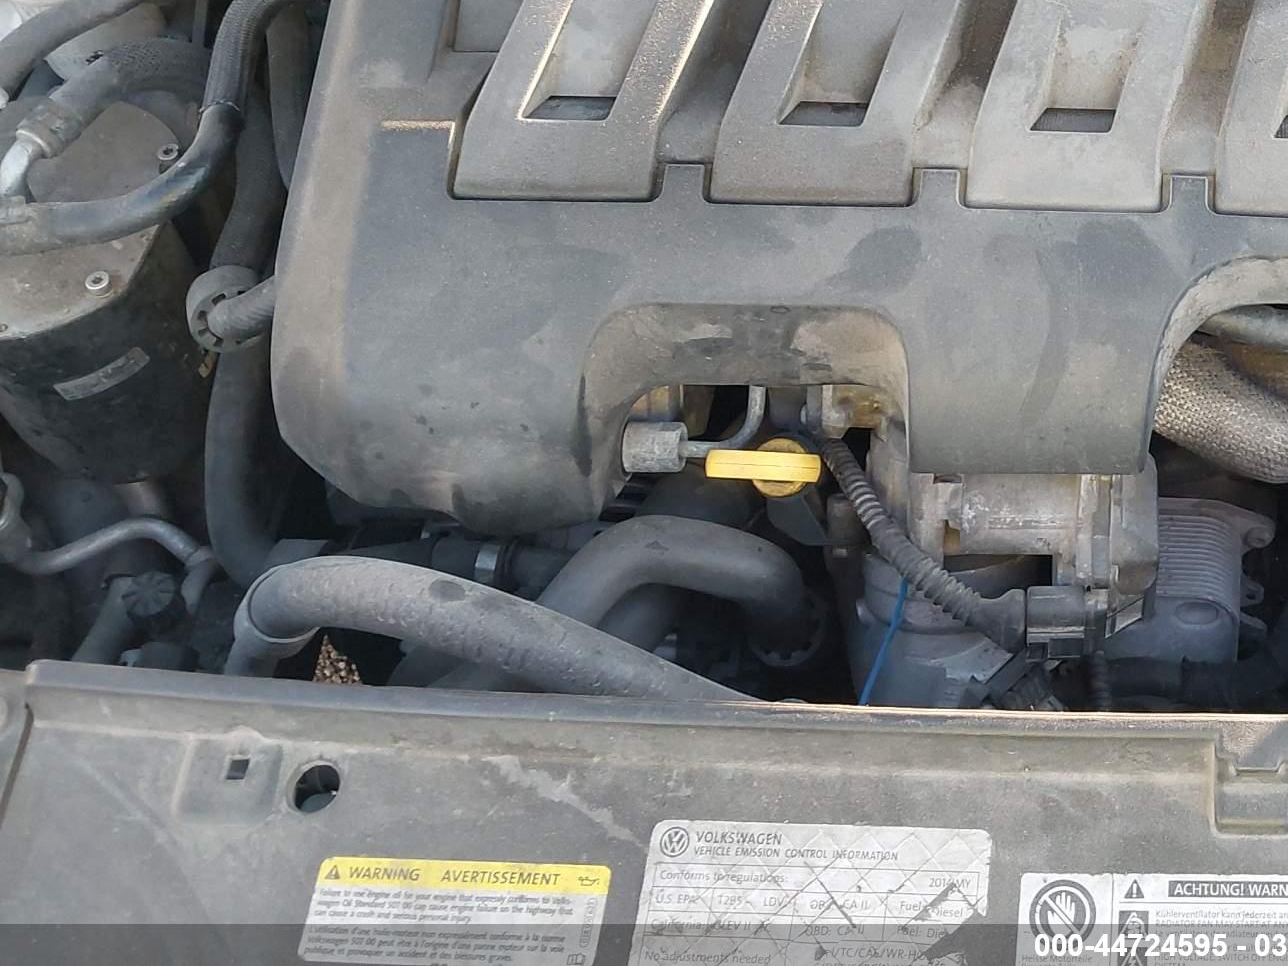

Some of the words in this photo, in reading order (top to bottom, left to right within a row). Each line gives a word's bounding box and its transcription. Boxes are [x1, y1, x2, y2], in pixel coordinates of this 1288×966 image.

[695, 830, 783, 846] VOLKSWAGEN
[694, 845, 731, 857] VEHICLE
[735, 846, 780, 858] EMISSION
[784, 847, 828, 859] CONTROL
[832, 849, 899, 861] INFORMATION
[348, 866, 420, 882] WARNING
[440, 869, 561, 886] AVERTISSEMENT
[1174, 882, 1244, 896] ACHTUNG!
[731, 951, 771, 965] needed
